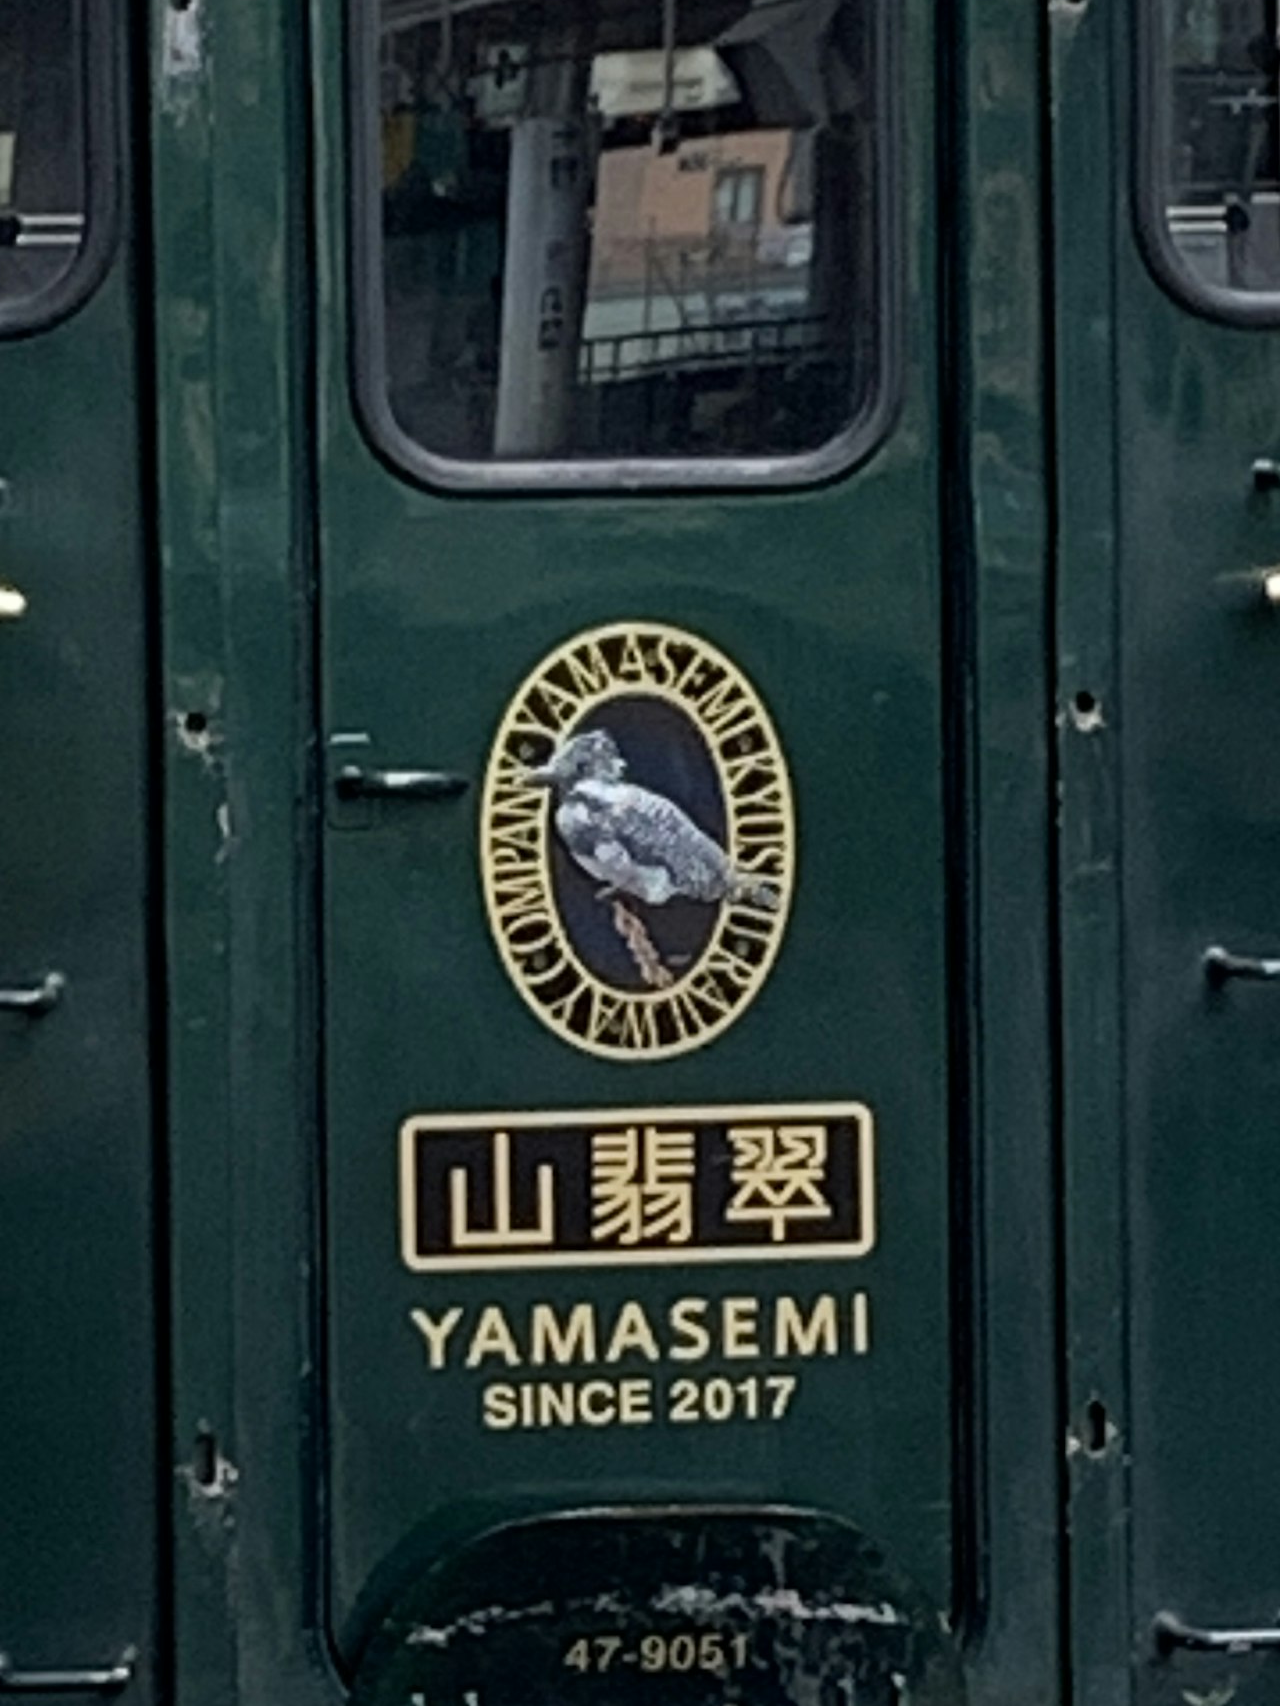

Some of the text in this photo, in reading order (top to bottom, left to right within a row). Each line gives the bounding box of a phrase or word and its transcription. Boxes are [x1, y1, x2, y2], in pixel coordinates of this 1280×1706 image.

[508, 633, 760, 743] YAMASEMI
[546, 943, 755, 1049] RAILWAY
[449, 1125, 833, 1247] 山翡翠
[410, 1293, 870, 1369] YAMASEMI
[482, 1376, 797, 1430] SINCE 2017
[564, 1635, 749, 1672] 47-9051
